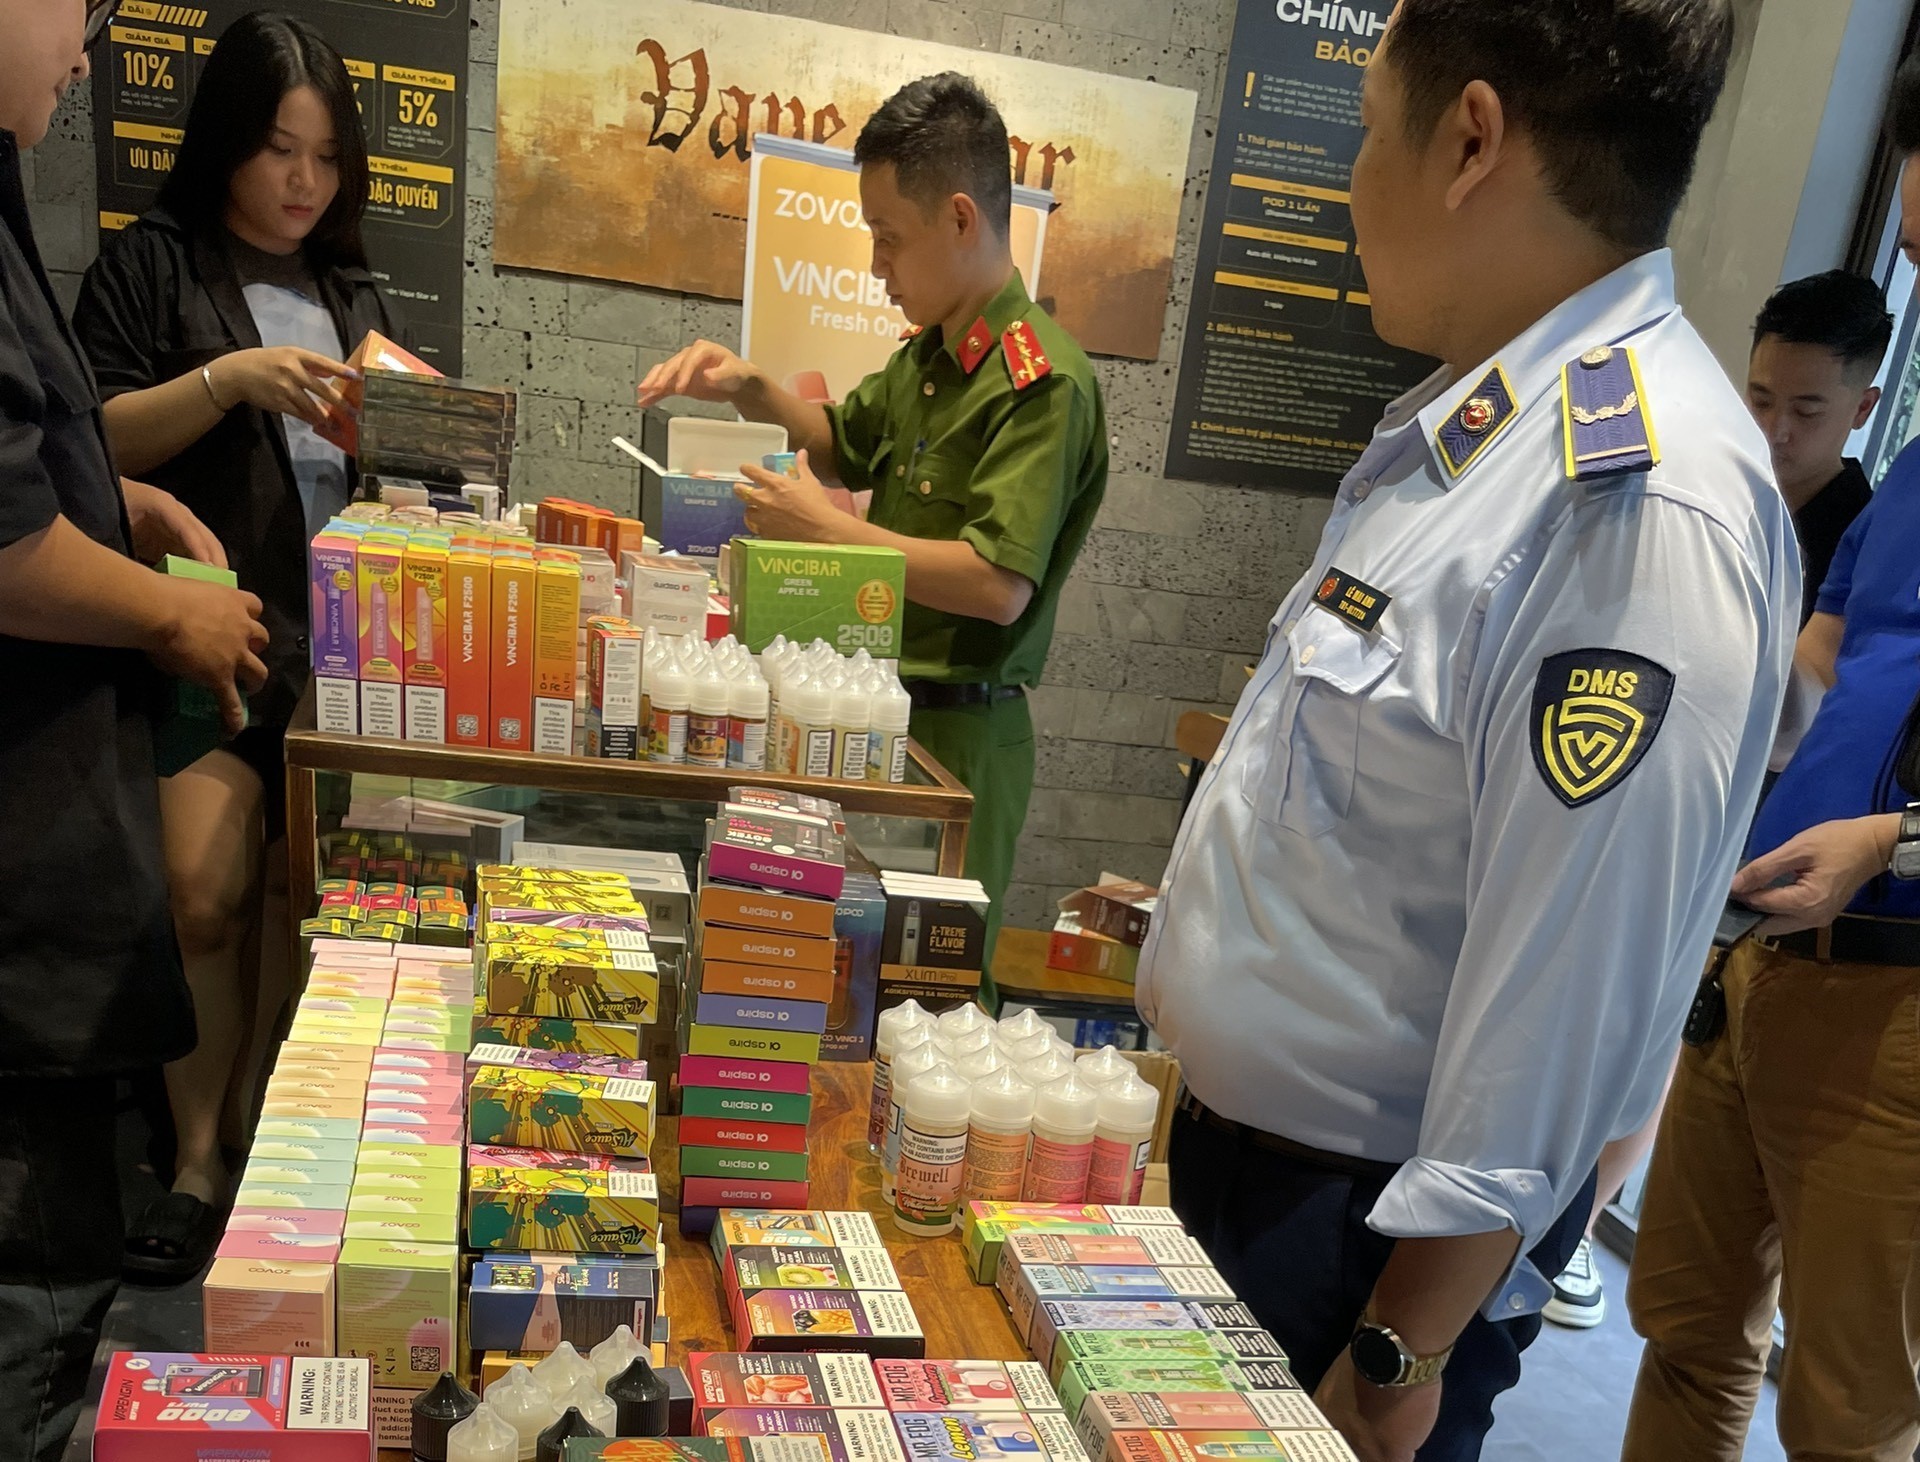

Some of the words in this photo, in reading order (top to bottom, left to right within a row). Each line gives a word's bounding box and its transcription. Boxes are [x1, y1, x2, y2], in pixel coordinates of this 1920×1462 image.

[1315, 39, 1374, 67] BẢO
[123, 51, 174, 90] 10%
[399, 89, 438, 128] 5%
[130, 147, 149, 169] ƯU
[773, 256, 902, 311] VINCIB
[810, 305, 869, 334] Fresh
[757, 556, 842, 577] VINCIBAR
[463, 576, 473, 609] F2500
[777, 587, 805, 596] APPLE
[806, 588, 820, 597] ICE
[783, 578, 813, 587] GREEN
[508, 580, 518, 613] F2500
[462, 613, 473, 663] VINCIBAR
[506, 616, 518, 667] VINCIBAR
[1567, 668, 1638, 699] DMS
[749, 862, 789, 876] aspire
[739, 905, 779, 918] aspire
[929, 936, 965, 949] FLAVOR
[930, 925, 967, 938] X-TREME
[742, 943, 781, 955] aspire
[742, 976, 781, 989] aspire
[736, 1008, 775, 1019] aspire
[728, 1039, 767, 1049] aspire
[718, 1070, 756, 1080] aspire
[720, 1100, 759, 1111] aspire
[584, 1126, 638, 1147] HiSauce
[717, 1130, 754, 1141] aspire
[718, 1159, 755, 1169] aspire
[900, 1156, 949, 1183] Brewell
[720, 1189, 758, 1200] aspire
[590, 1224, 647, 1245] HiSauce
[832, 1216, 849, 1240] WARNING:
[248, 1267, 292, 1275] ZOVOO
[848, 1254, 866, 1282] WARNING:
[866, 1298, 886, 1328] WARNING:
[322, 1361, 332, 1385] CONTAINS
[350, 1366, 358, 1392] CHEMICAL.
[823, 1362, 844, 1397] WARNING:
[882, 1365, 910, 1383] FOG
[1008, 1368, 1032, 1400] WARNING:
[299, 1367, 316, 1415] WARNING:
[335, 1375, 345, 1397] NICOTINE
[890, 1386, 917, 1401] MR
[113, 1379, 134, 1421] VAPENGIN
[321, 1386, 331, 1410] PRODUCT
[348, 1393, 357, 1419] ADDICTIVE
[1099, 1395, 1123, 1408] FOG
[156, 1408, 251, 1422] 8000
[320, 1410, 329, 1423] THIS
[334, 1398, 344, 1423] NICOTINE.
[1109, 1411, 1131, 1421] MR
[843, 1419, 865, 1457] WARNING:
[903, 1419, 933, 1437] FOG
[936, 1417, 976, 1459] Lemon
[1032, 1421, 1061, 1453] WARNING:
[911, 1441, 940, 1457] MR
